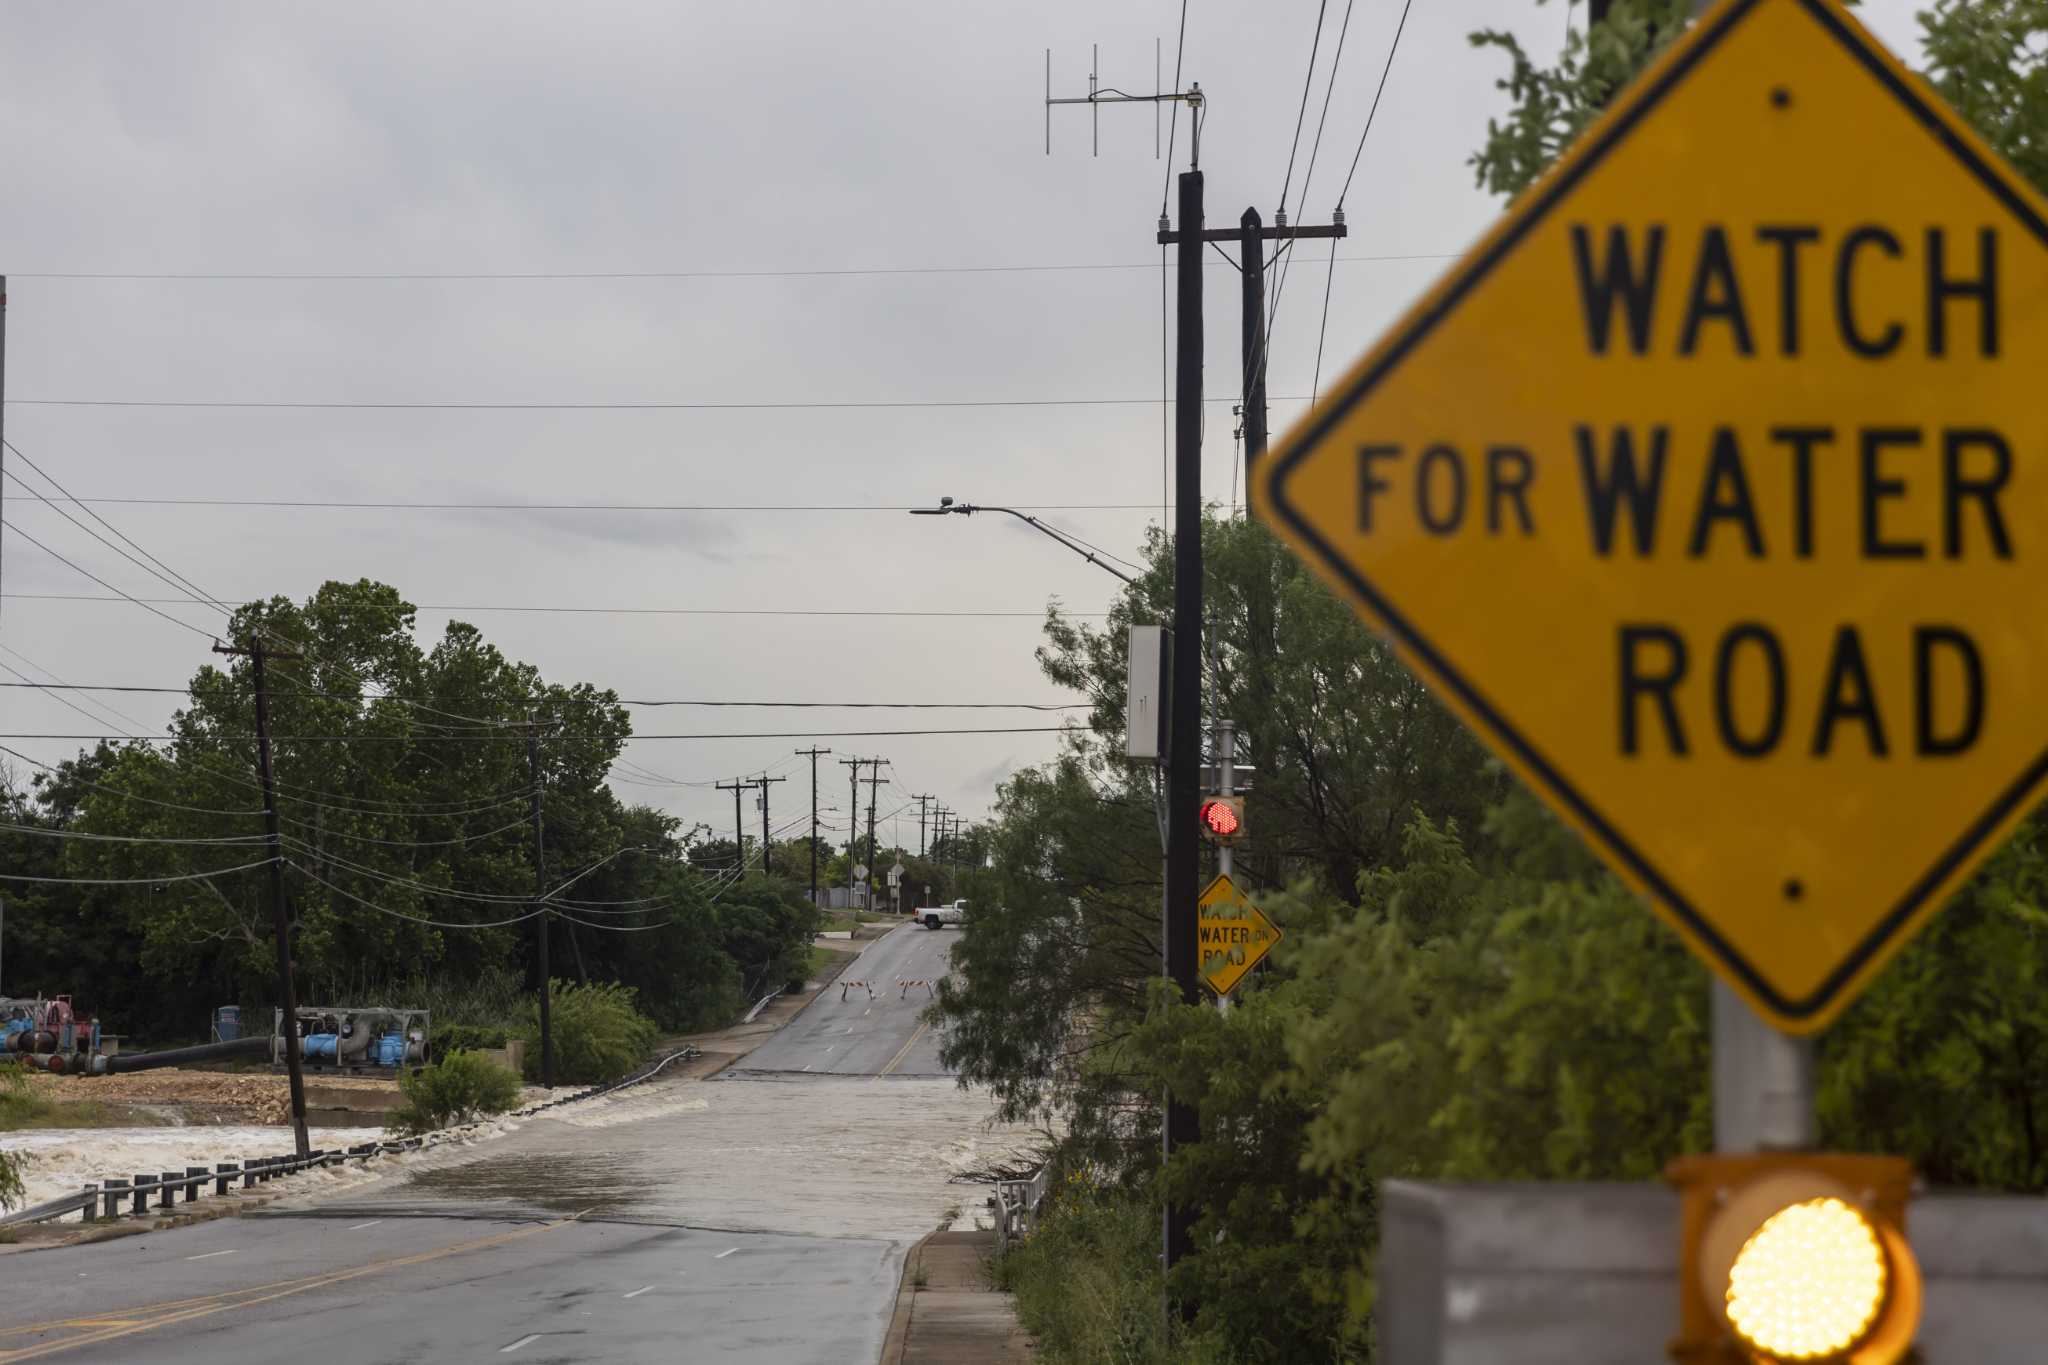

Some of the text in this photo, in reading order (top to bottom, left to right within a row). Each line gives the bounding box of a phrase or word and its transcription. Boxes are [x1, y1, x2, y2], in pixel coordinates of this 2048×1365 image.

[1571, 223, 2000, 360] WATCH
[1356, 423, 2016, 561] FOR WATER
[1616, 621, 1988, 761] ROAD
[1200, 927, 1249, 943] WATER
